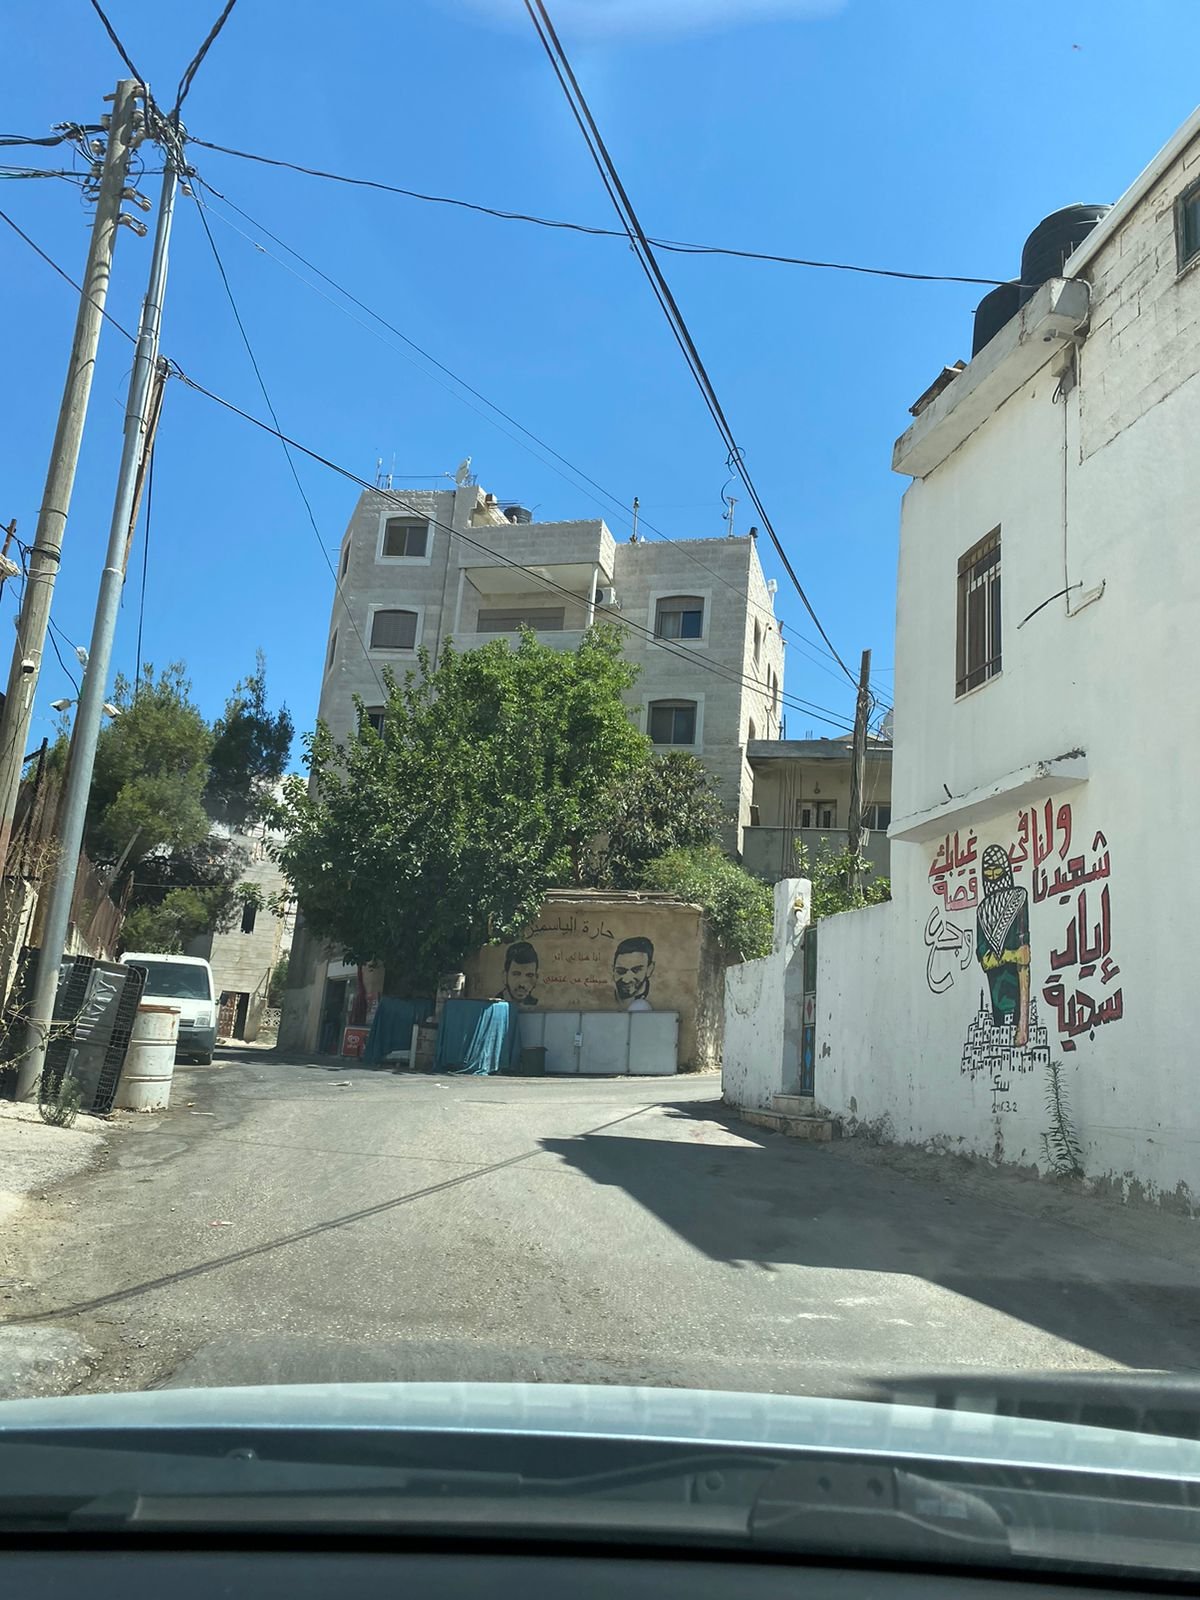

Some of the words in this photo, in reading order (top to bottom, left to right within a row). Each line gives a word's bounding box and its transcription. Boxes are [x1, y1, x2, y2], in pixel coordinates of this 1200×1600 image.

[928, 828, 978, 881] غيابك
[1008, 810, 1029, 873] في
[1031, 797, 1072, 868] ولنا
[932, 868, 978, 911] قصة
[582, 920, 615, 940] حارة
[924, 906, 974, 994] وجع
